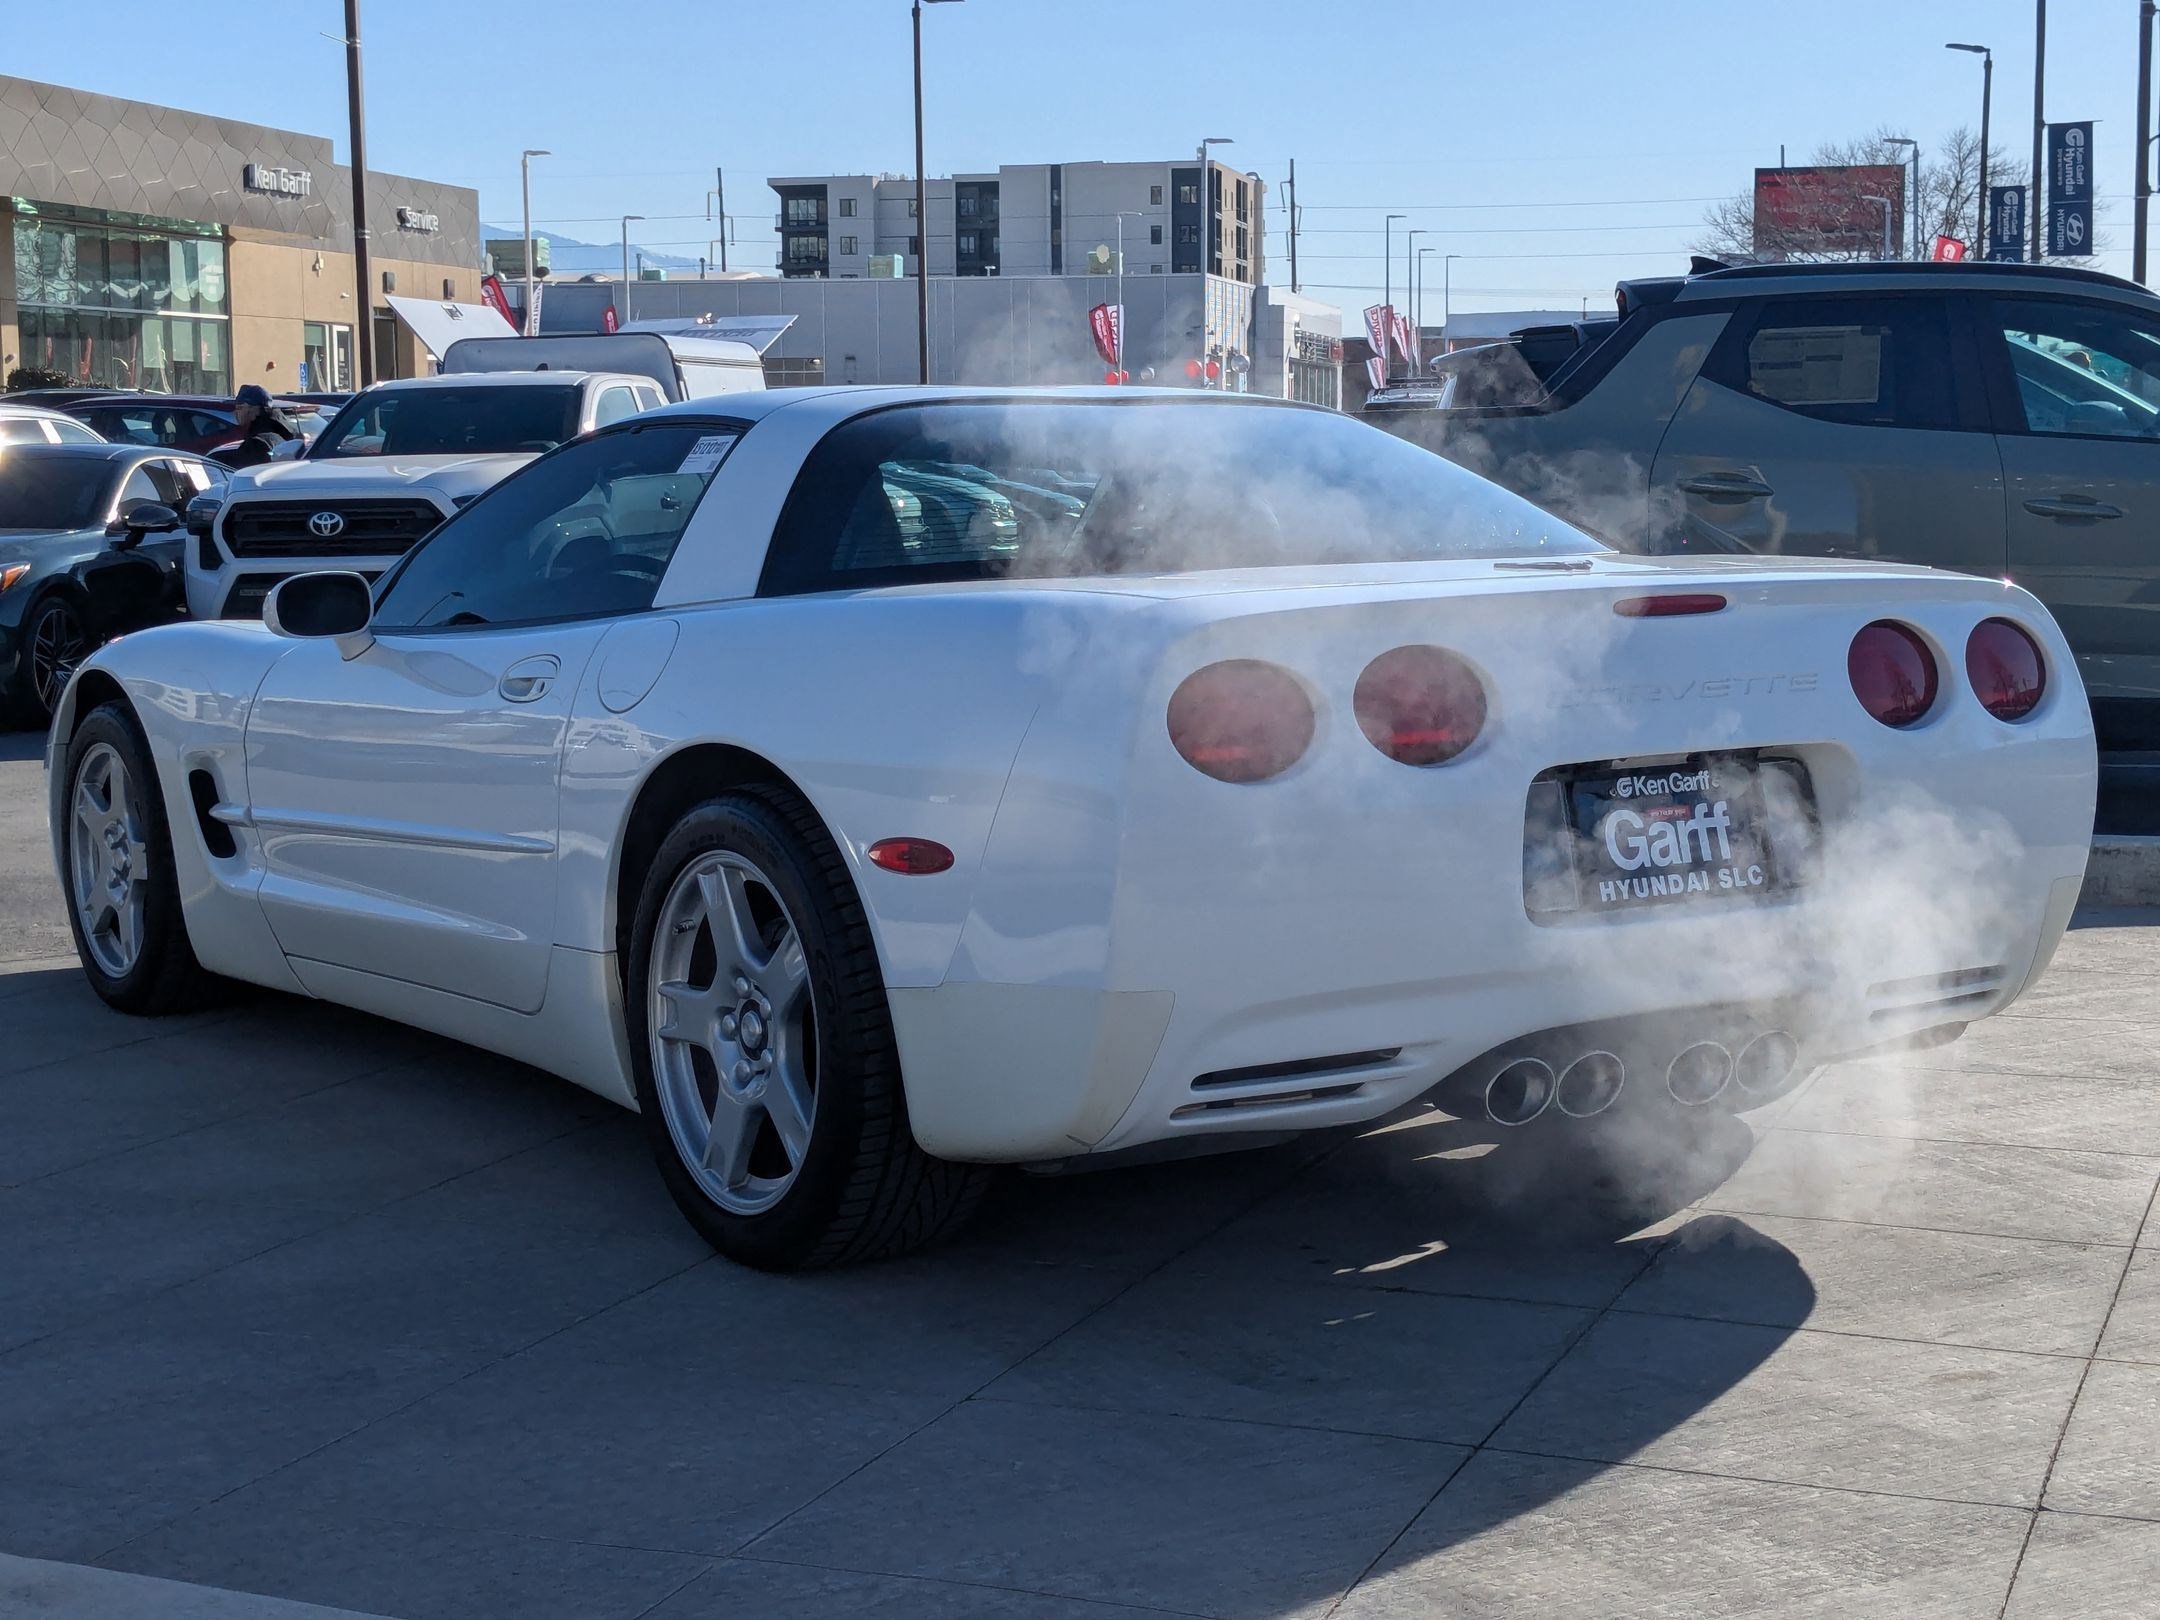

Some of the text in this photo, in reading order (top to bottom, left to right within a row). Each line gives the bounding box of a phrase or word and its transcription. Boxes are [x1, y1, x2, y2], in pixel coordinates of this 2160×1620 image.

[254, 163, 311, 196] Ken Garff
[2063, 147, 2076, 195] Hyundai
[404, 209, 439, 231] Service
[2056, 209, 2065, 251] HYUNDAI
[1604, 800, 1732, 871] Garff
[1599, 864, 1764, 902] HYUNDAI SLC
